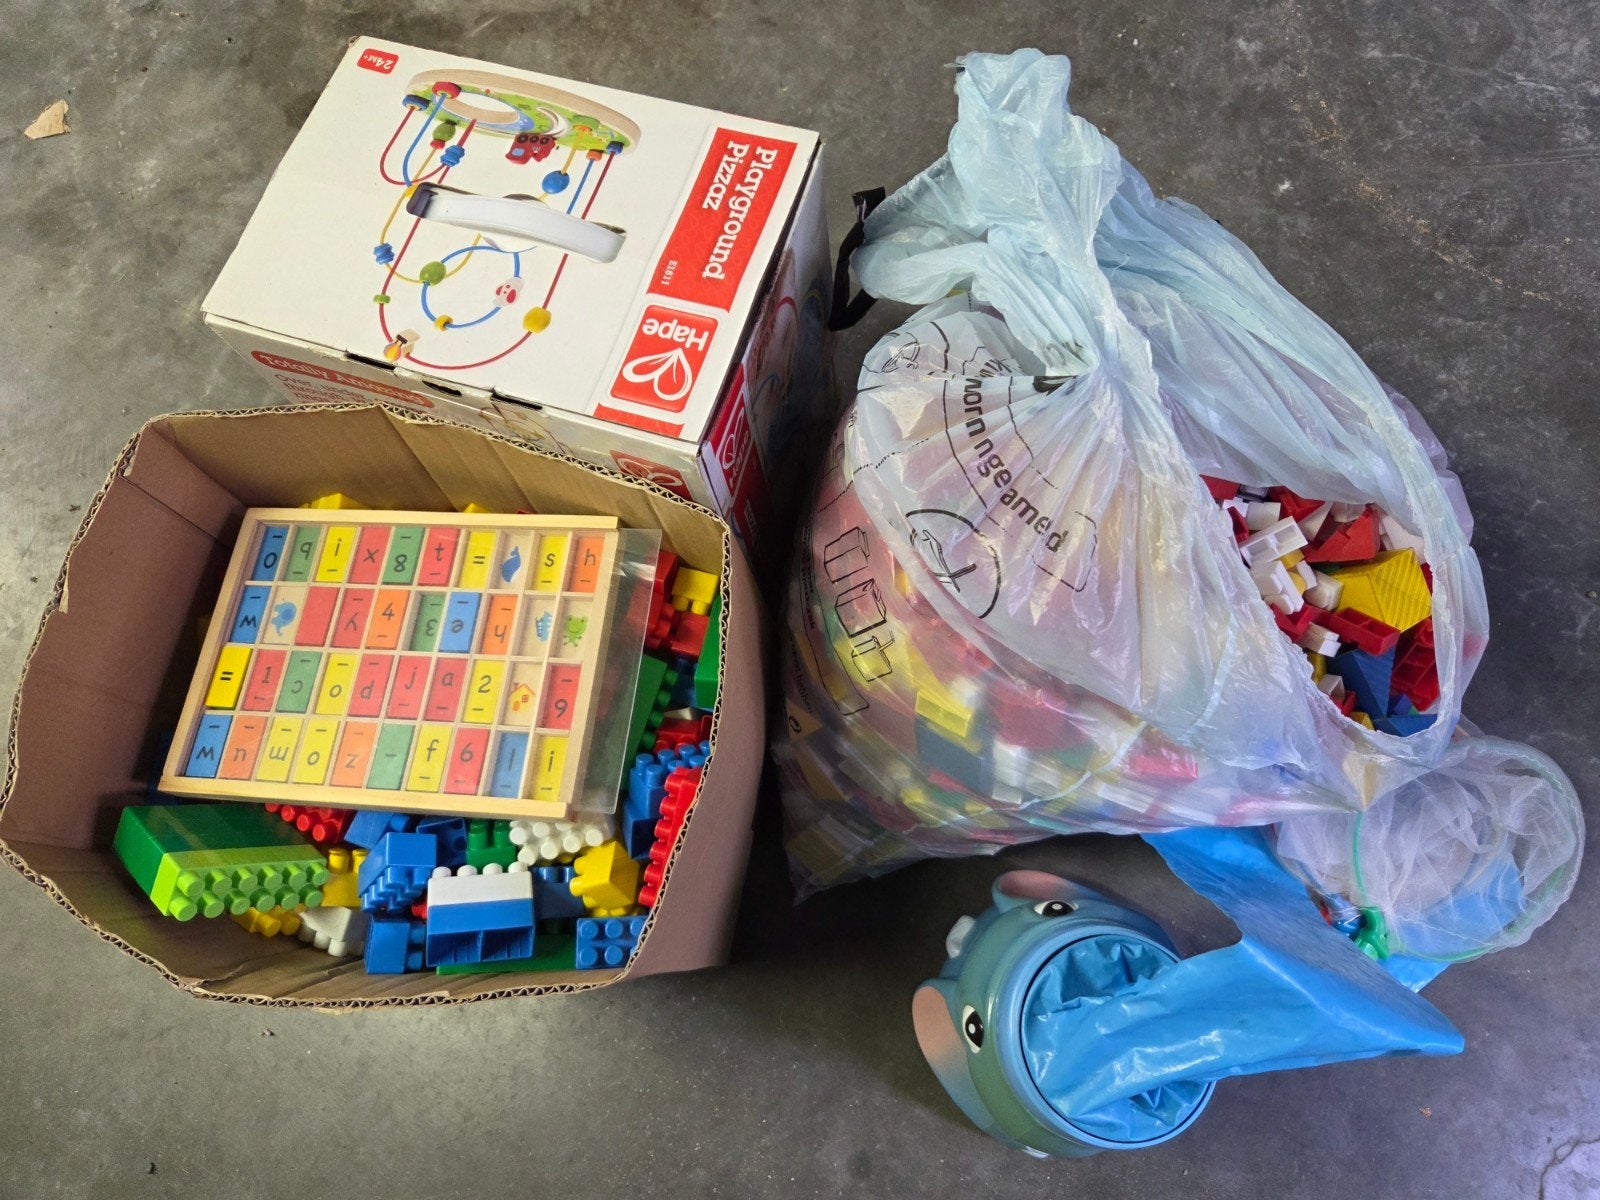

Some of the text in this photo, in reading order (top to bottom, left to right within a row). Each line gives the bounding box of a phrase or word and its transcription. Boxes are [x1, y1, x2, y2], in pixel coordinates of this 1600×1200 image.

[702, 140, 750, 211] Pizzaz
[702, 146, 778, 280] Playground
[642, 318, 710, 352] Hape
[363, 548, 379, 563] x
[394, 554, 407, 572] 8
[435, 543, 445, 561] t
[545, 553, 556, 567] s
[584, 548, 597, 566] h
[382, 602, 395, 621] 4
[405, 667, 418, 690] j
[441, 672, 454, 686] a
[478, 675, 492, 693] 2
[427, 738, 439, 762] f
